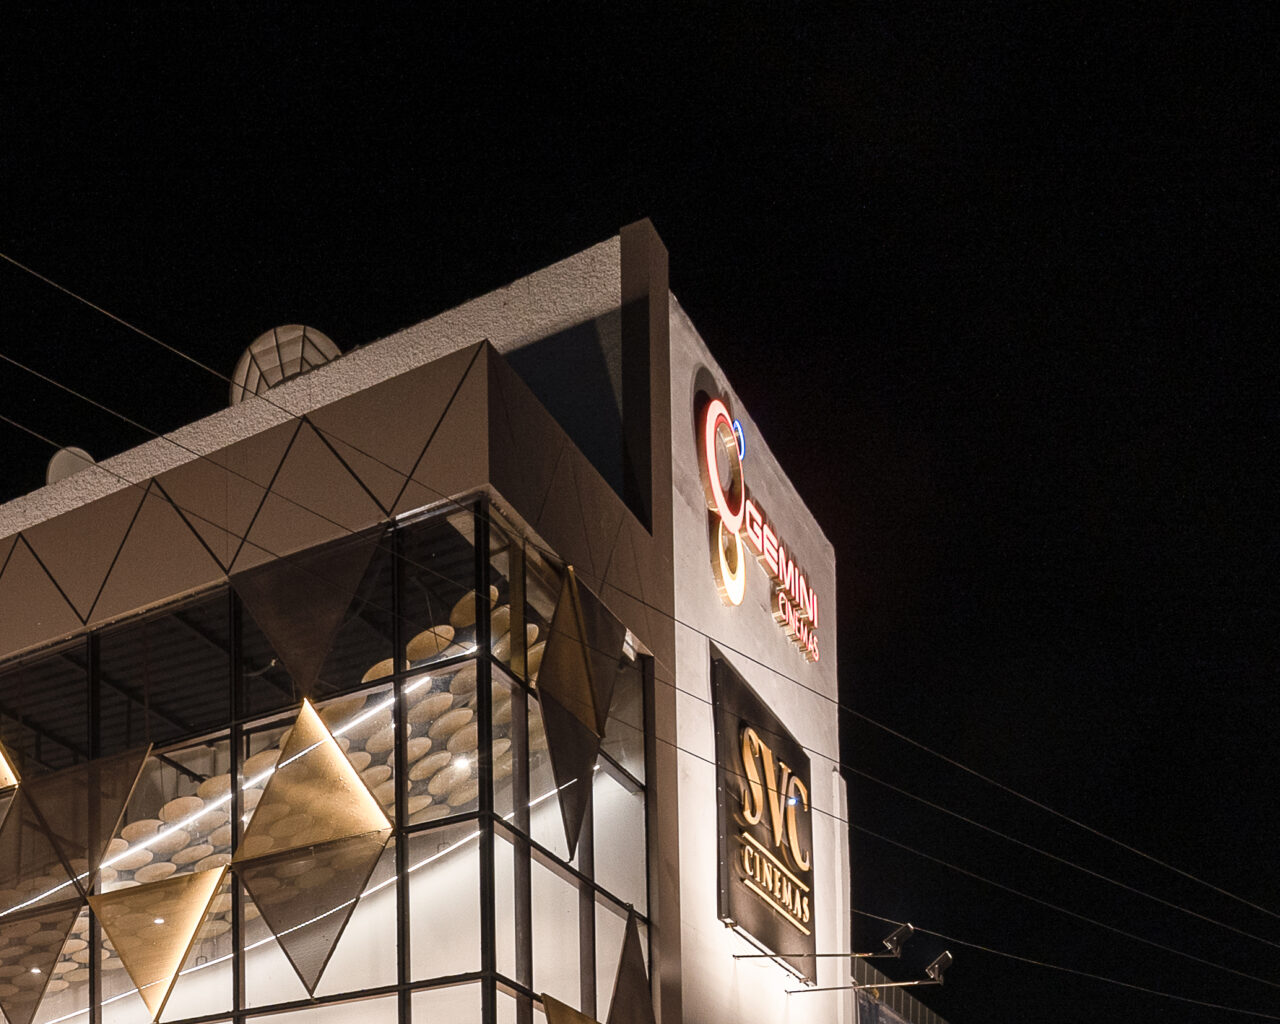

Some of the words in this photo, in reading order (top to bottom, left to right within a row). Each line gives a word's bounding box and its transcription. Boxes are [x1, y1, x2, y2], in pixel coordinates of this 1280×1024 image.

[745, 499, 818, 629] GEMINI
[742, 726, 810, 872] SVC
[744, 845, 811, 923] CINEMAS
